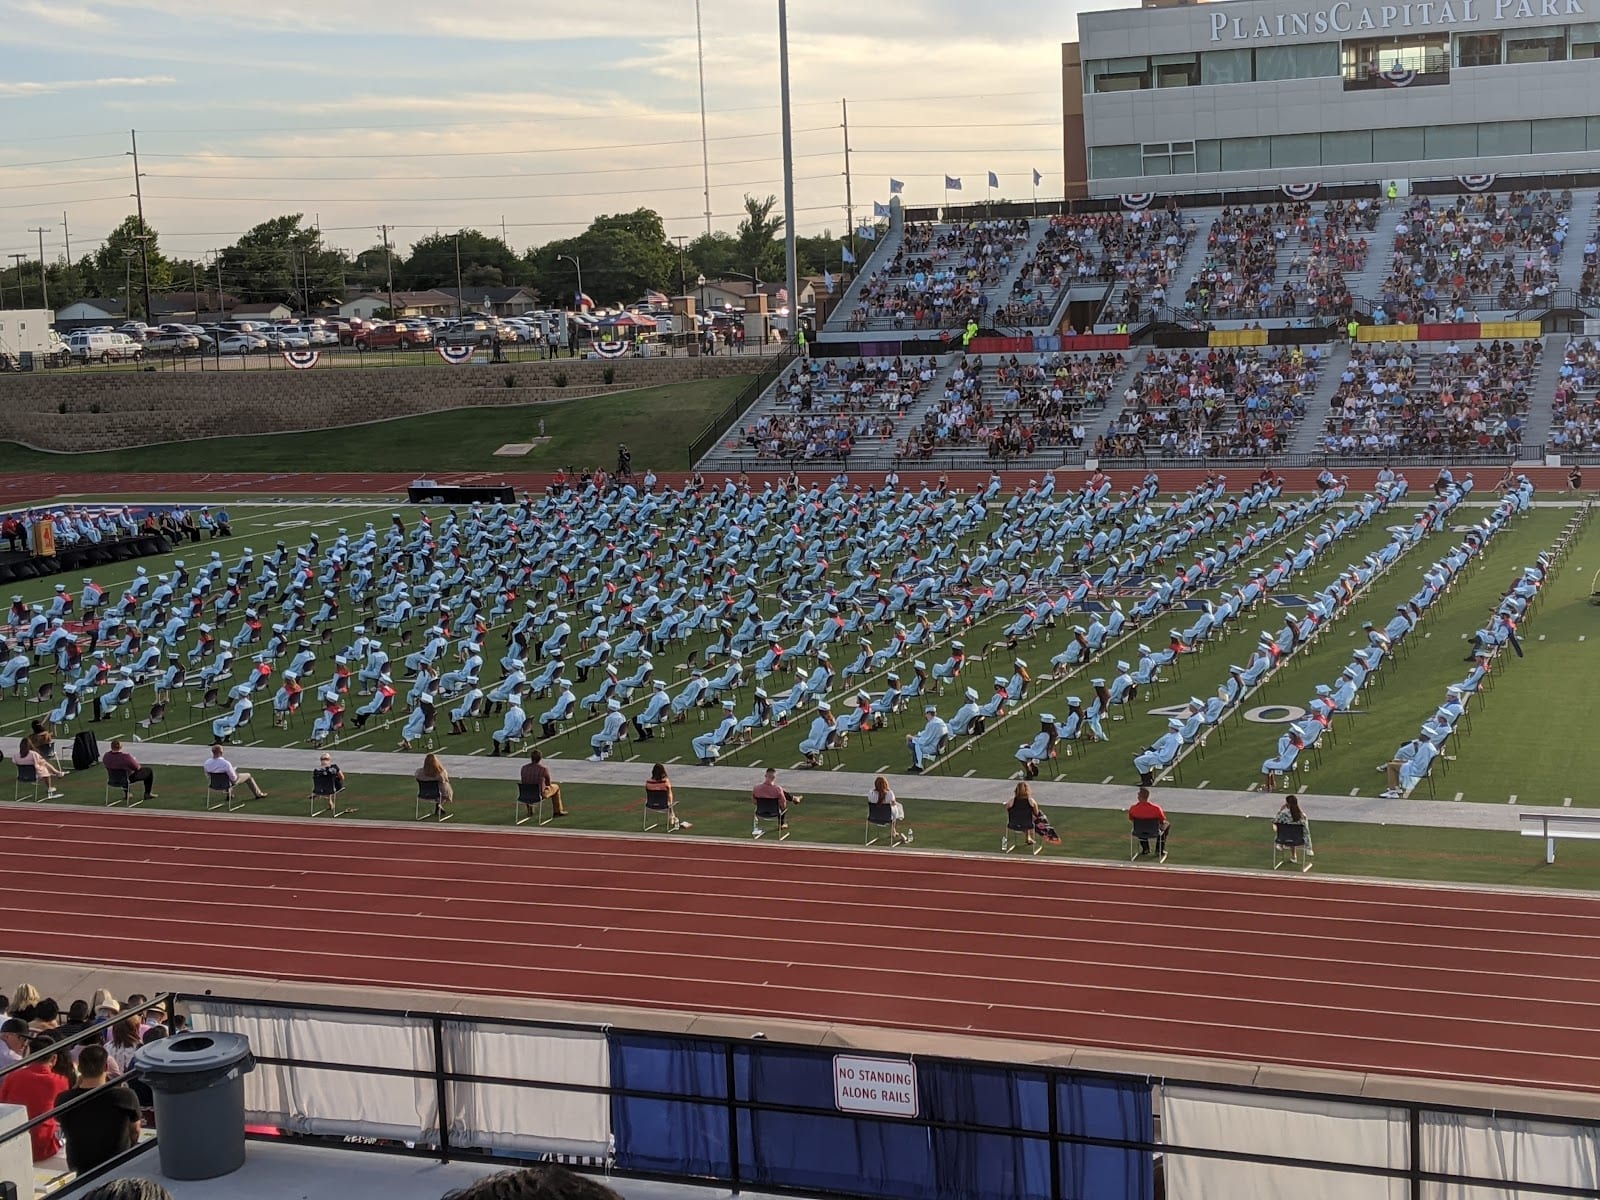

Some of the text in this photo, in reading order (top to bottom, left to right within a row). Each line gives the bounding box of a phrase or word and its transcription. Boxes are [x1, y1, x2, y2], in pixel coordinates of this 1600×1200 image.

[840, 1068, 911, 1085] NO STANDING
[842, 1086, 910, 1103] ALONG RAILS
